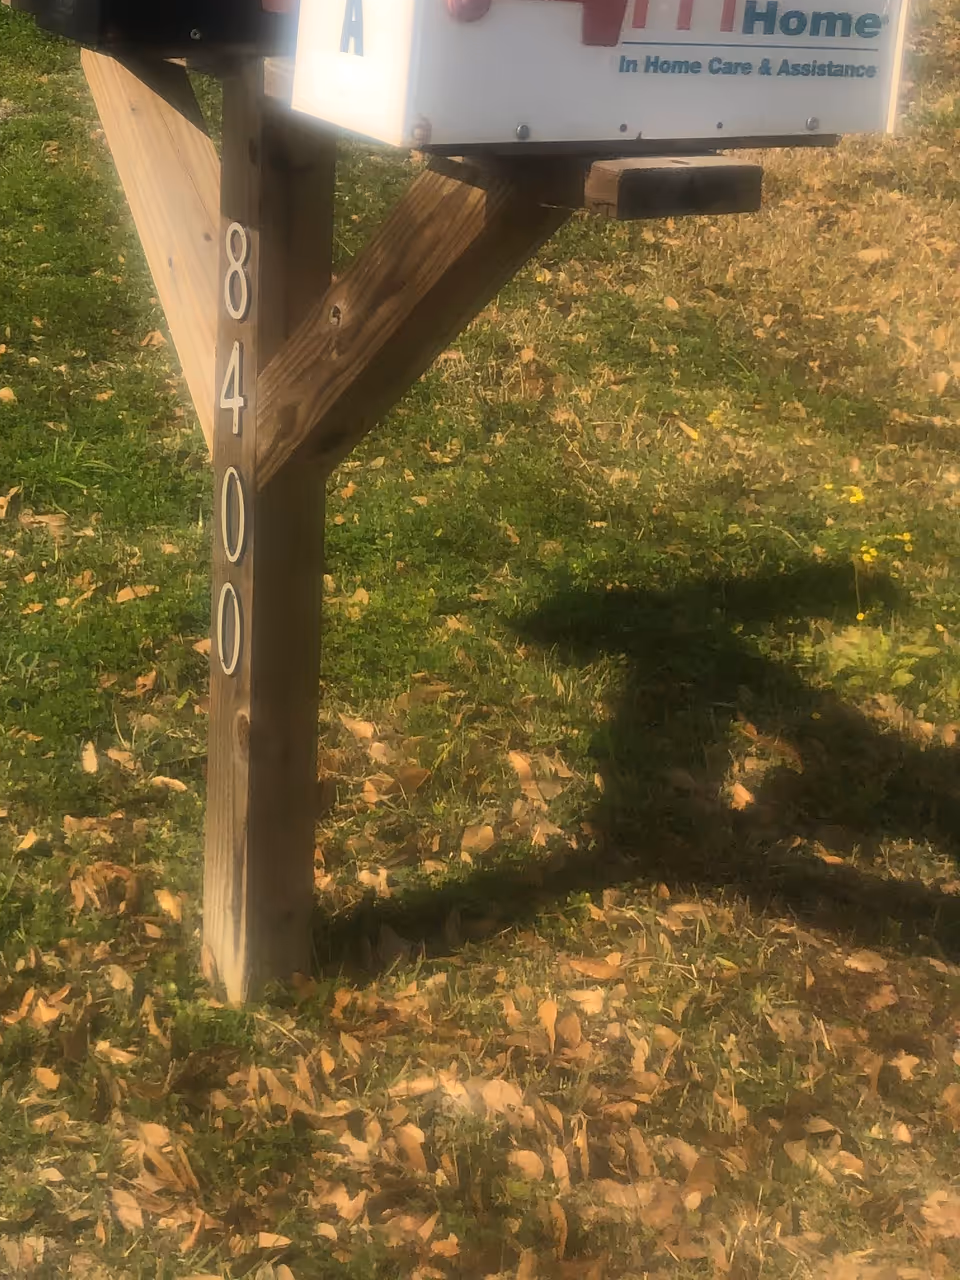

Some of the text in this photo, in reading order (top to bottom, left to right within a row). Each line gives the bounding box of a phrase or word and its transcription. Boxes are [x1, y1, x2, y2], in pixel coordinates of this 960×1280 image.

[742, 0, 882, 38] Home
[618, 55, 878, 78] In Home Care & Assistance
[216, 221, 248, 676] 8400
